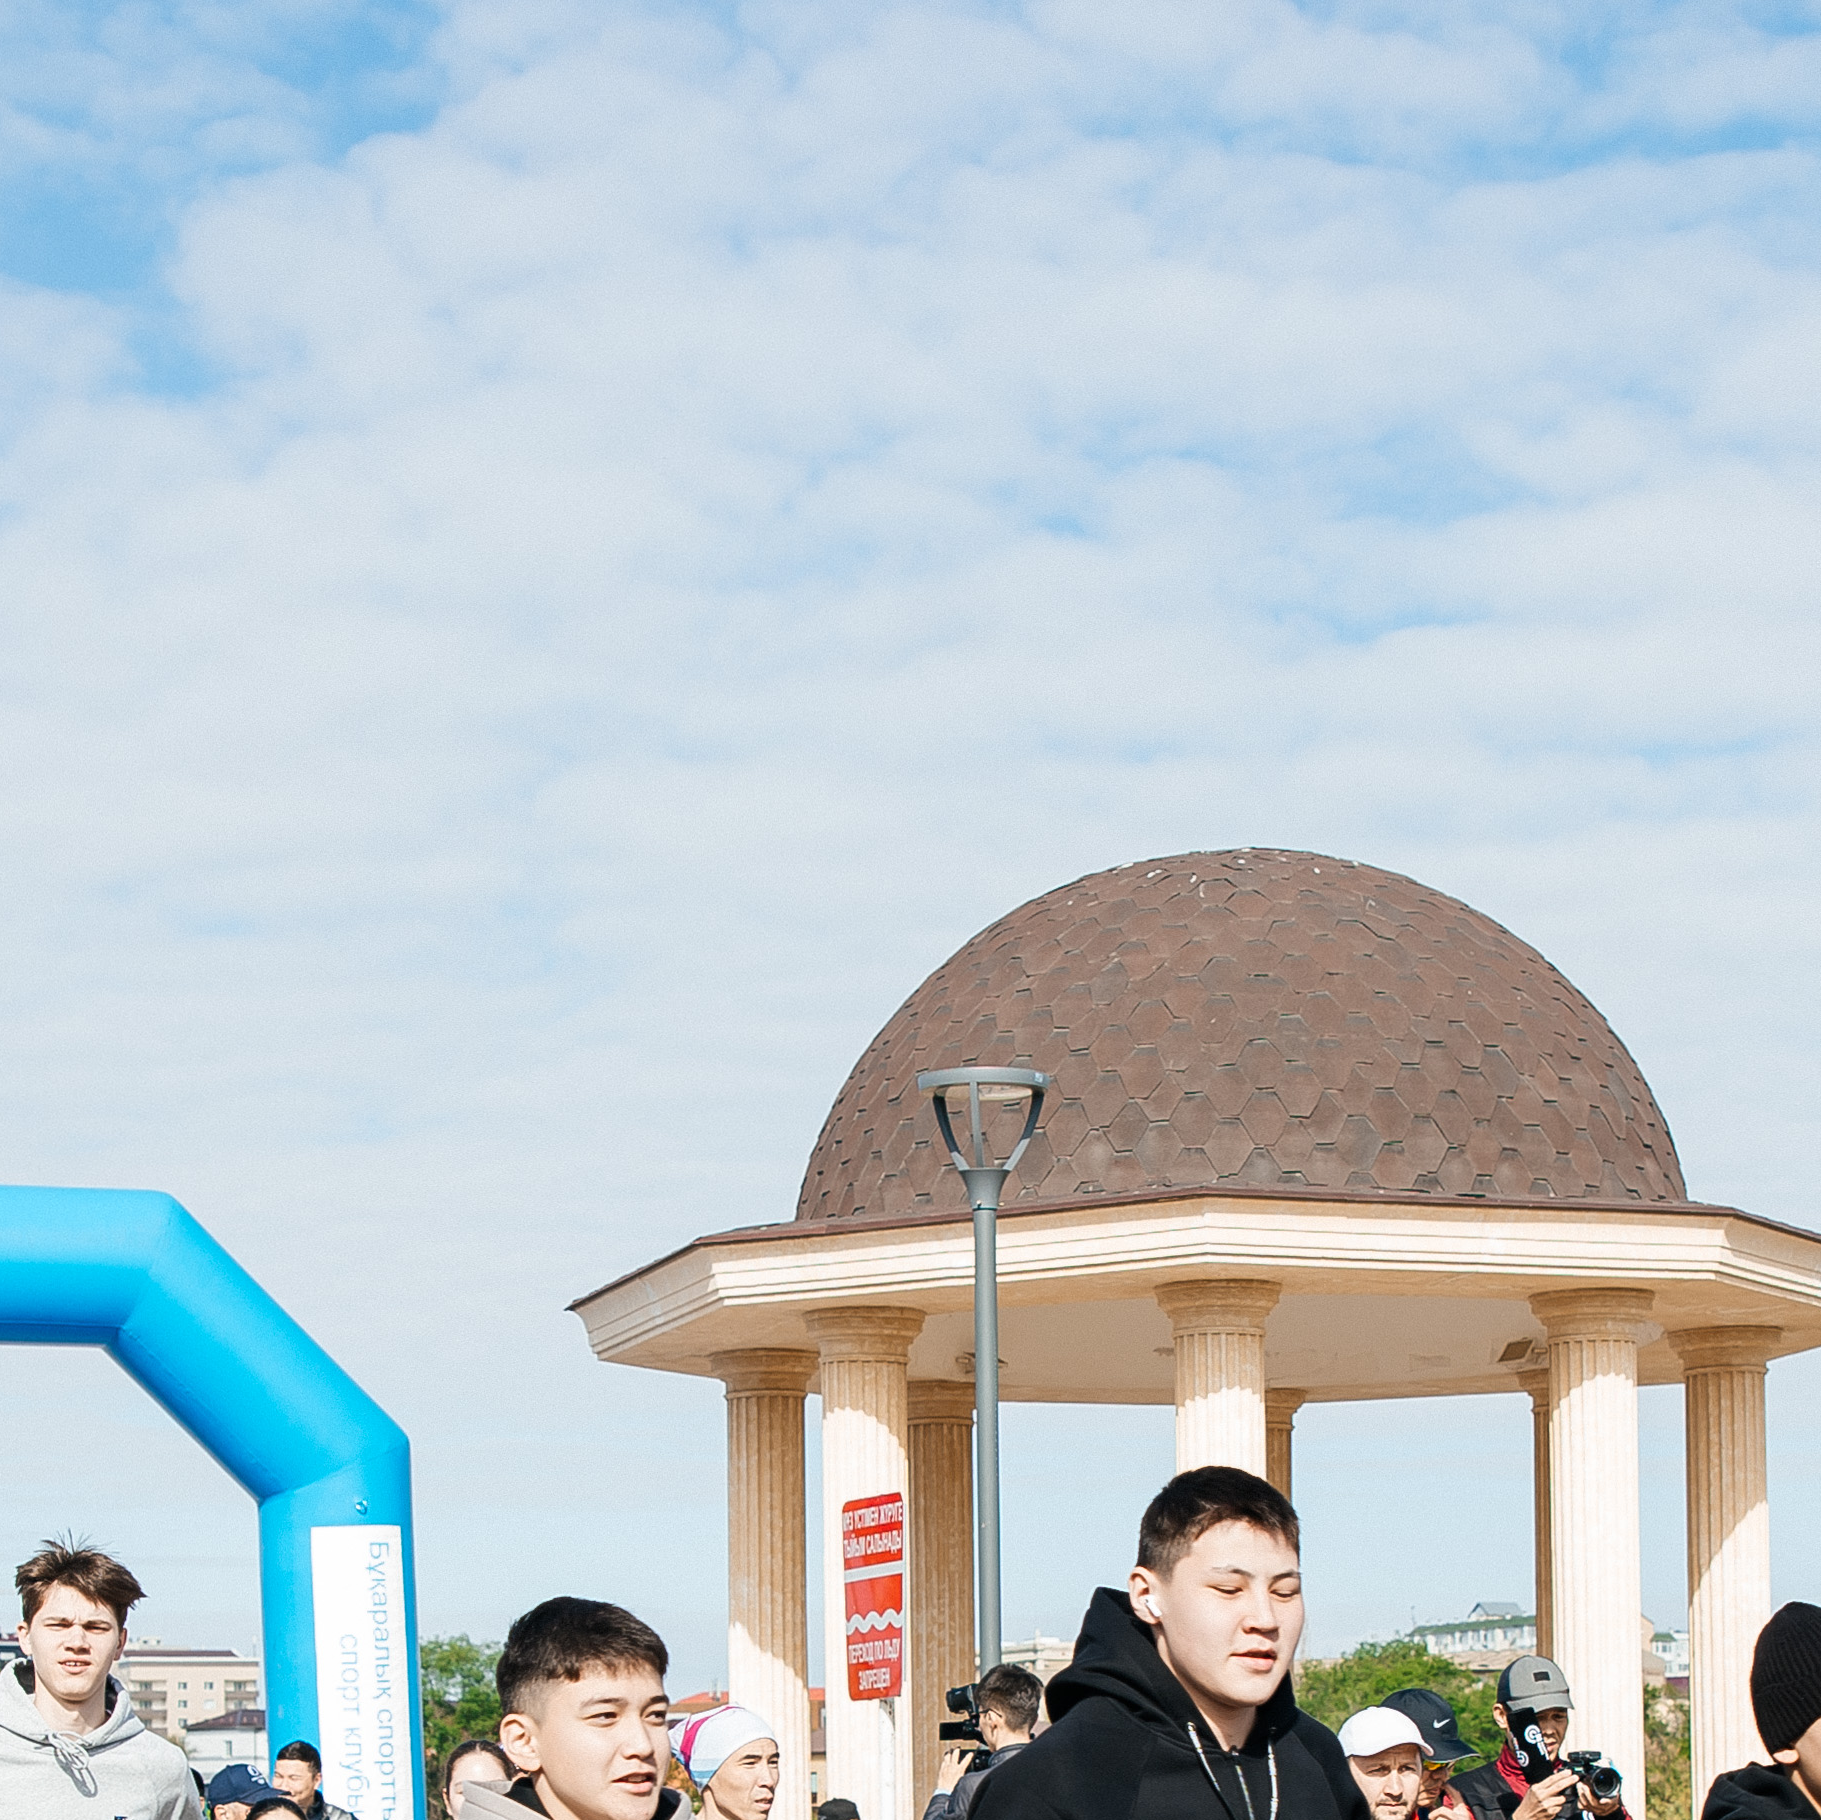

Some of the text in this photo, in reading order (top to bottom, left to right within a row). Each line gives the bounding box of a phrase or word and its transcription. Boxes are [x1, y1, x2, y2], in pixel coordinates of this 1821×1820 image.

[848, 1637, 901, 1666] ПЕРЕХОД ПО ЛЬДУ
[859, 1667, 890, 1691] ЗАПРЕЩЕН
[335, 1633, 370, 1815] спорт клубы
